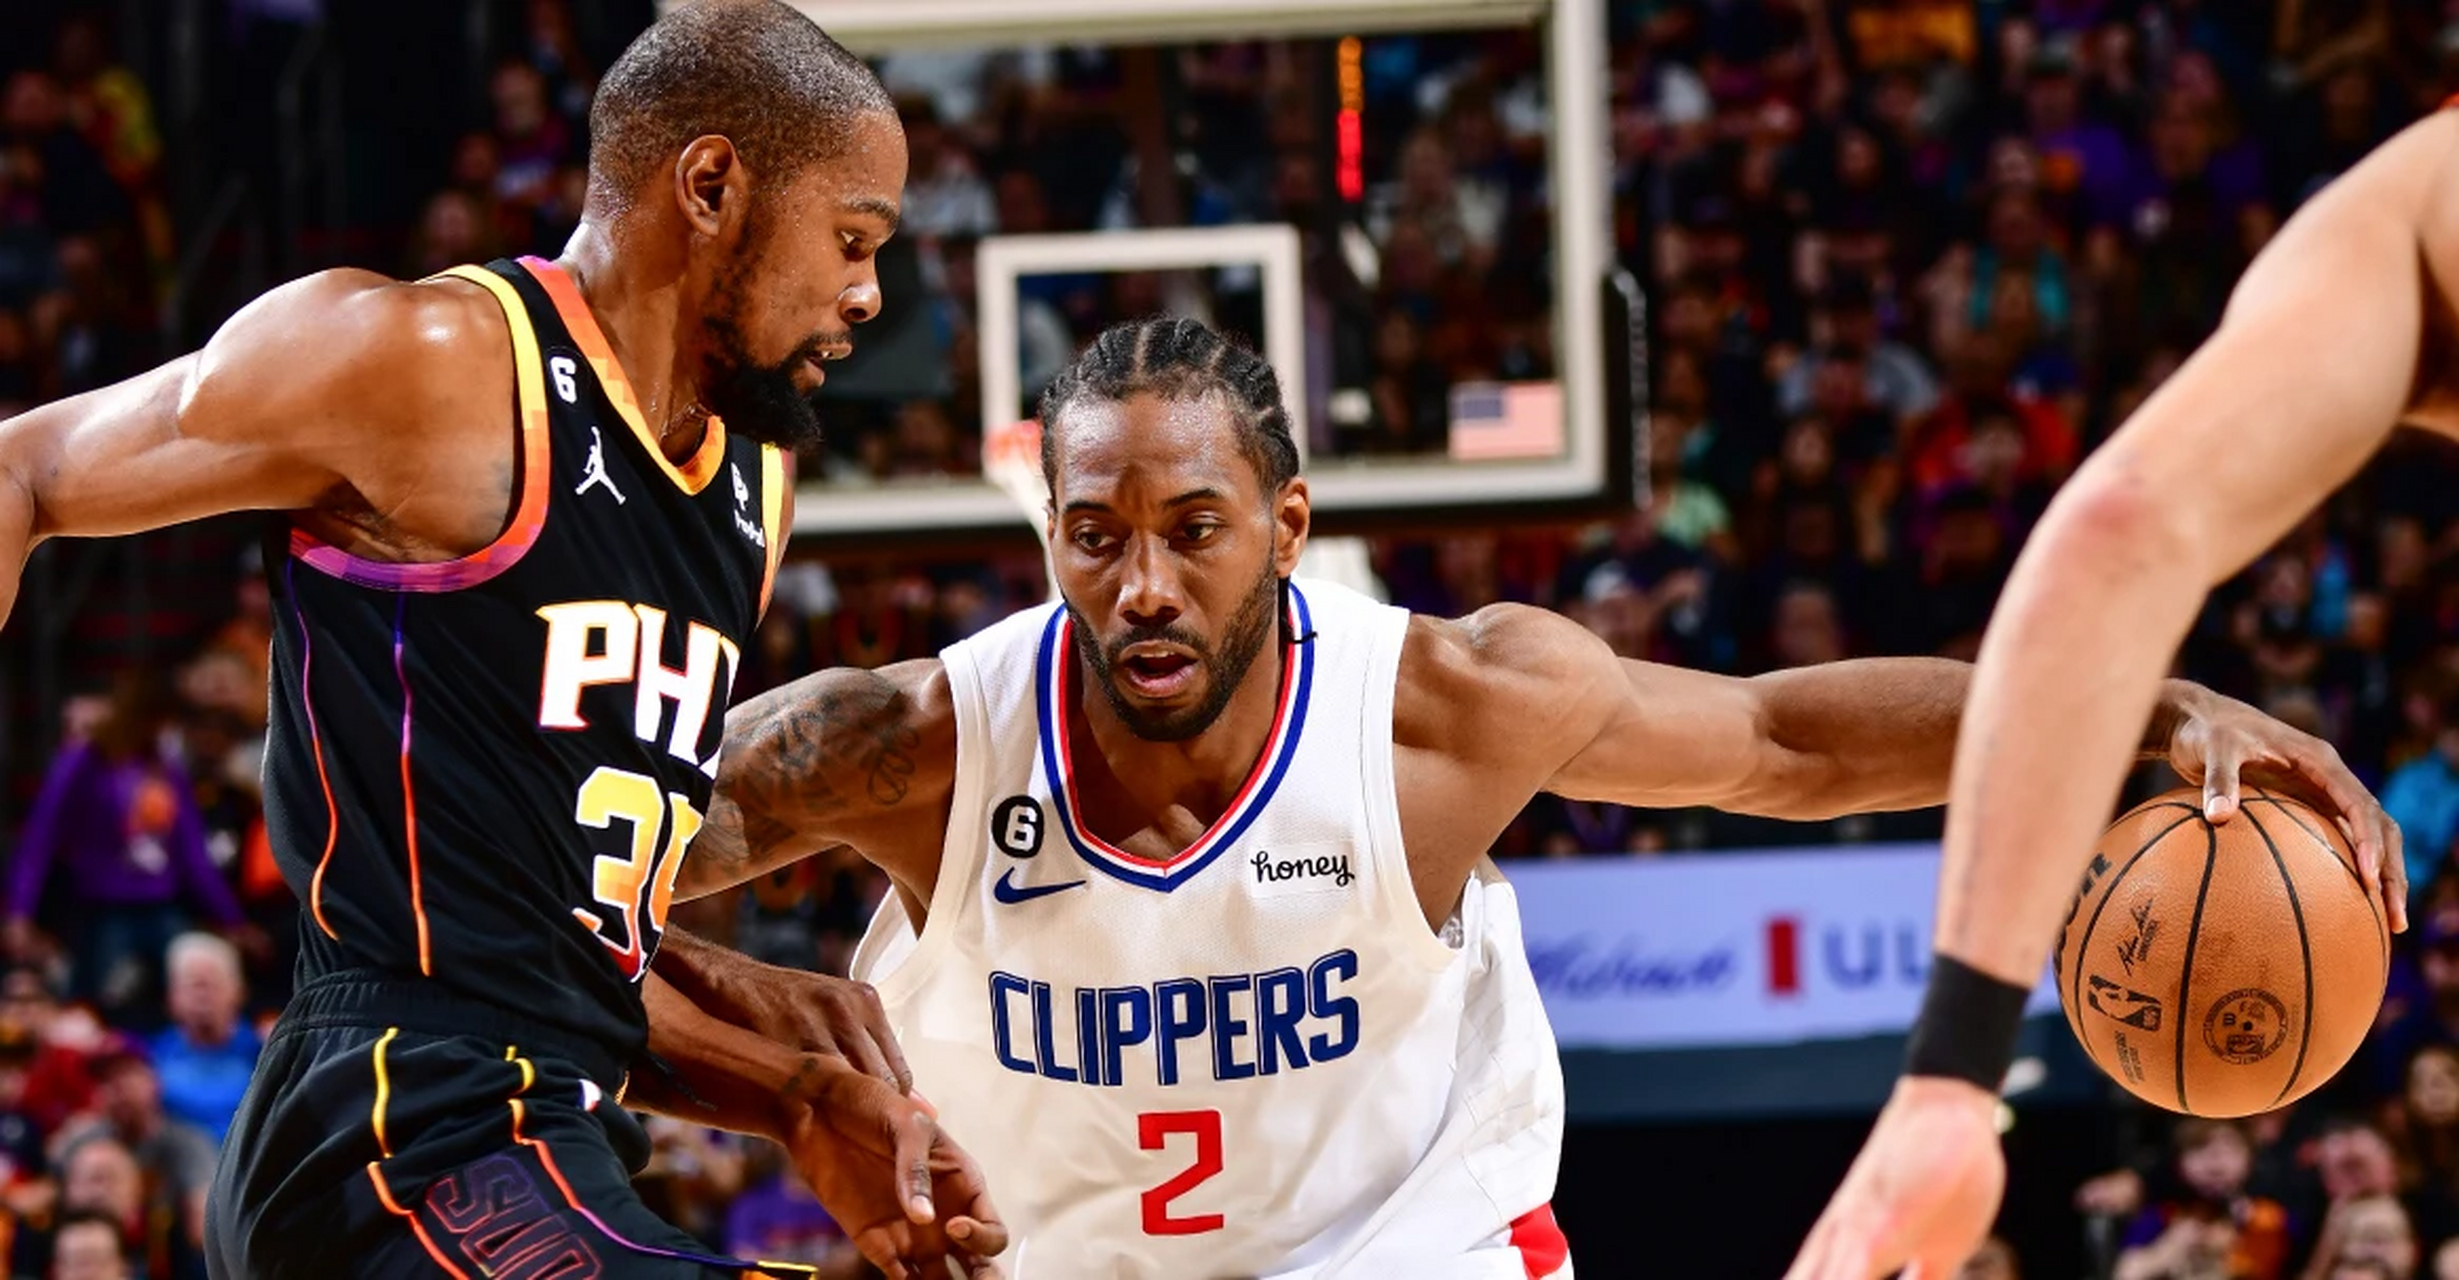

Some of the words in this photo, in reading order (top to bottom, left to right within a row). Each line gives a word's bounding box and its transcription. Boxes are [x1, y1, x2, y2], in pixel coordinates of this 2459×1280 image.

[550, 356, 578, 403] 6
[1004, 803, 1037, 860] 6
[1250, 850, 1355, 887] honey
[988, 948, 1360, 1086] CLIPPERS
[1138, 1109, 1225, 1236] 2
